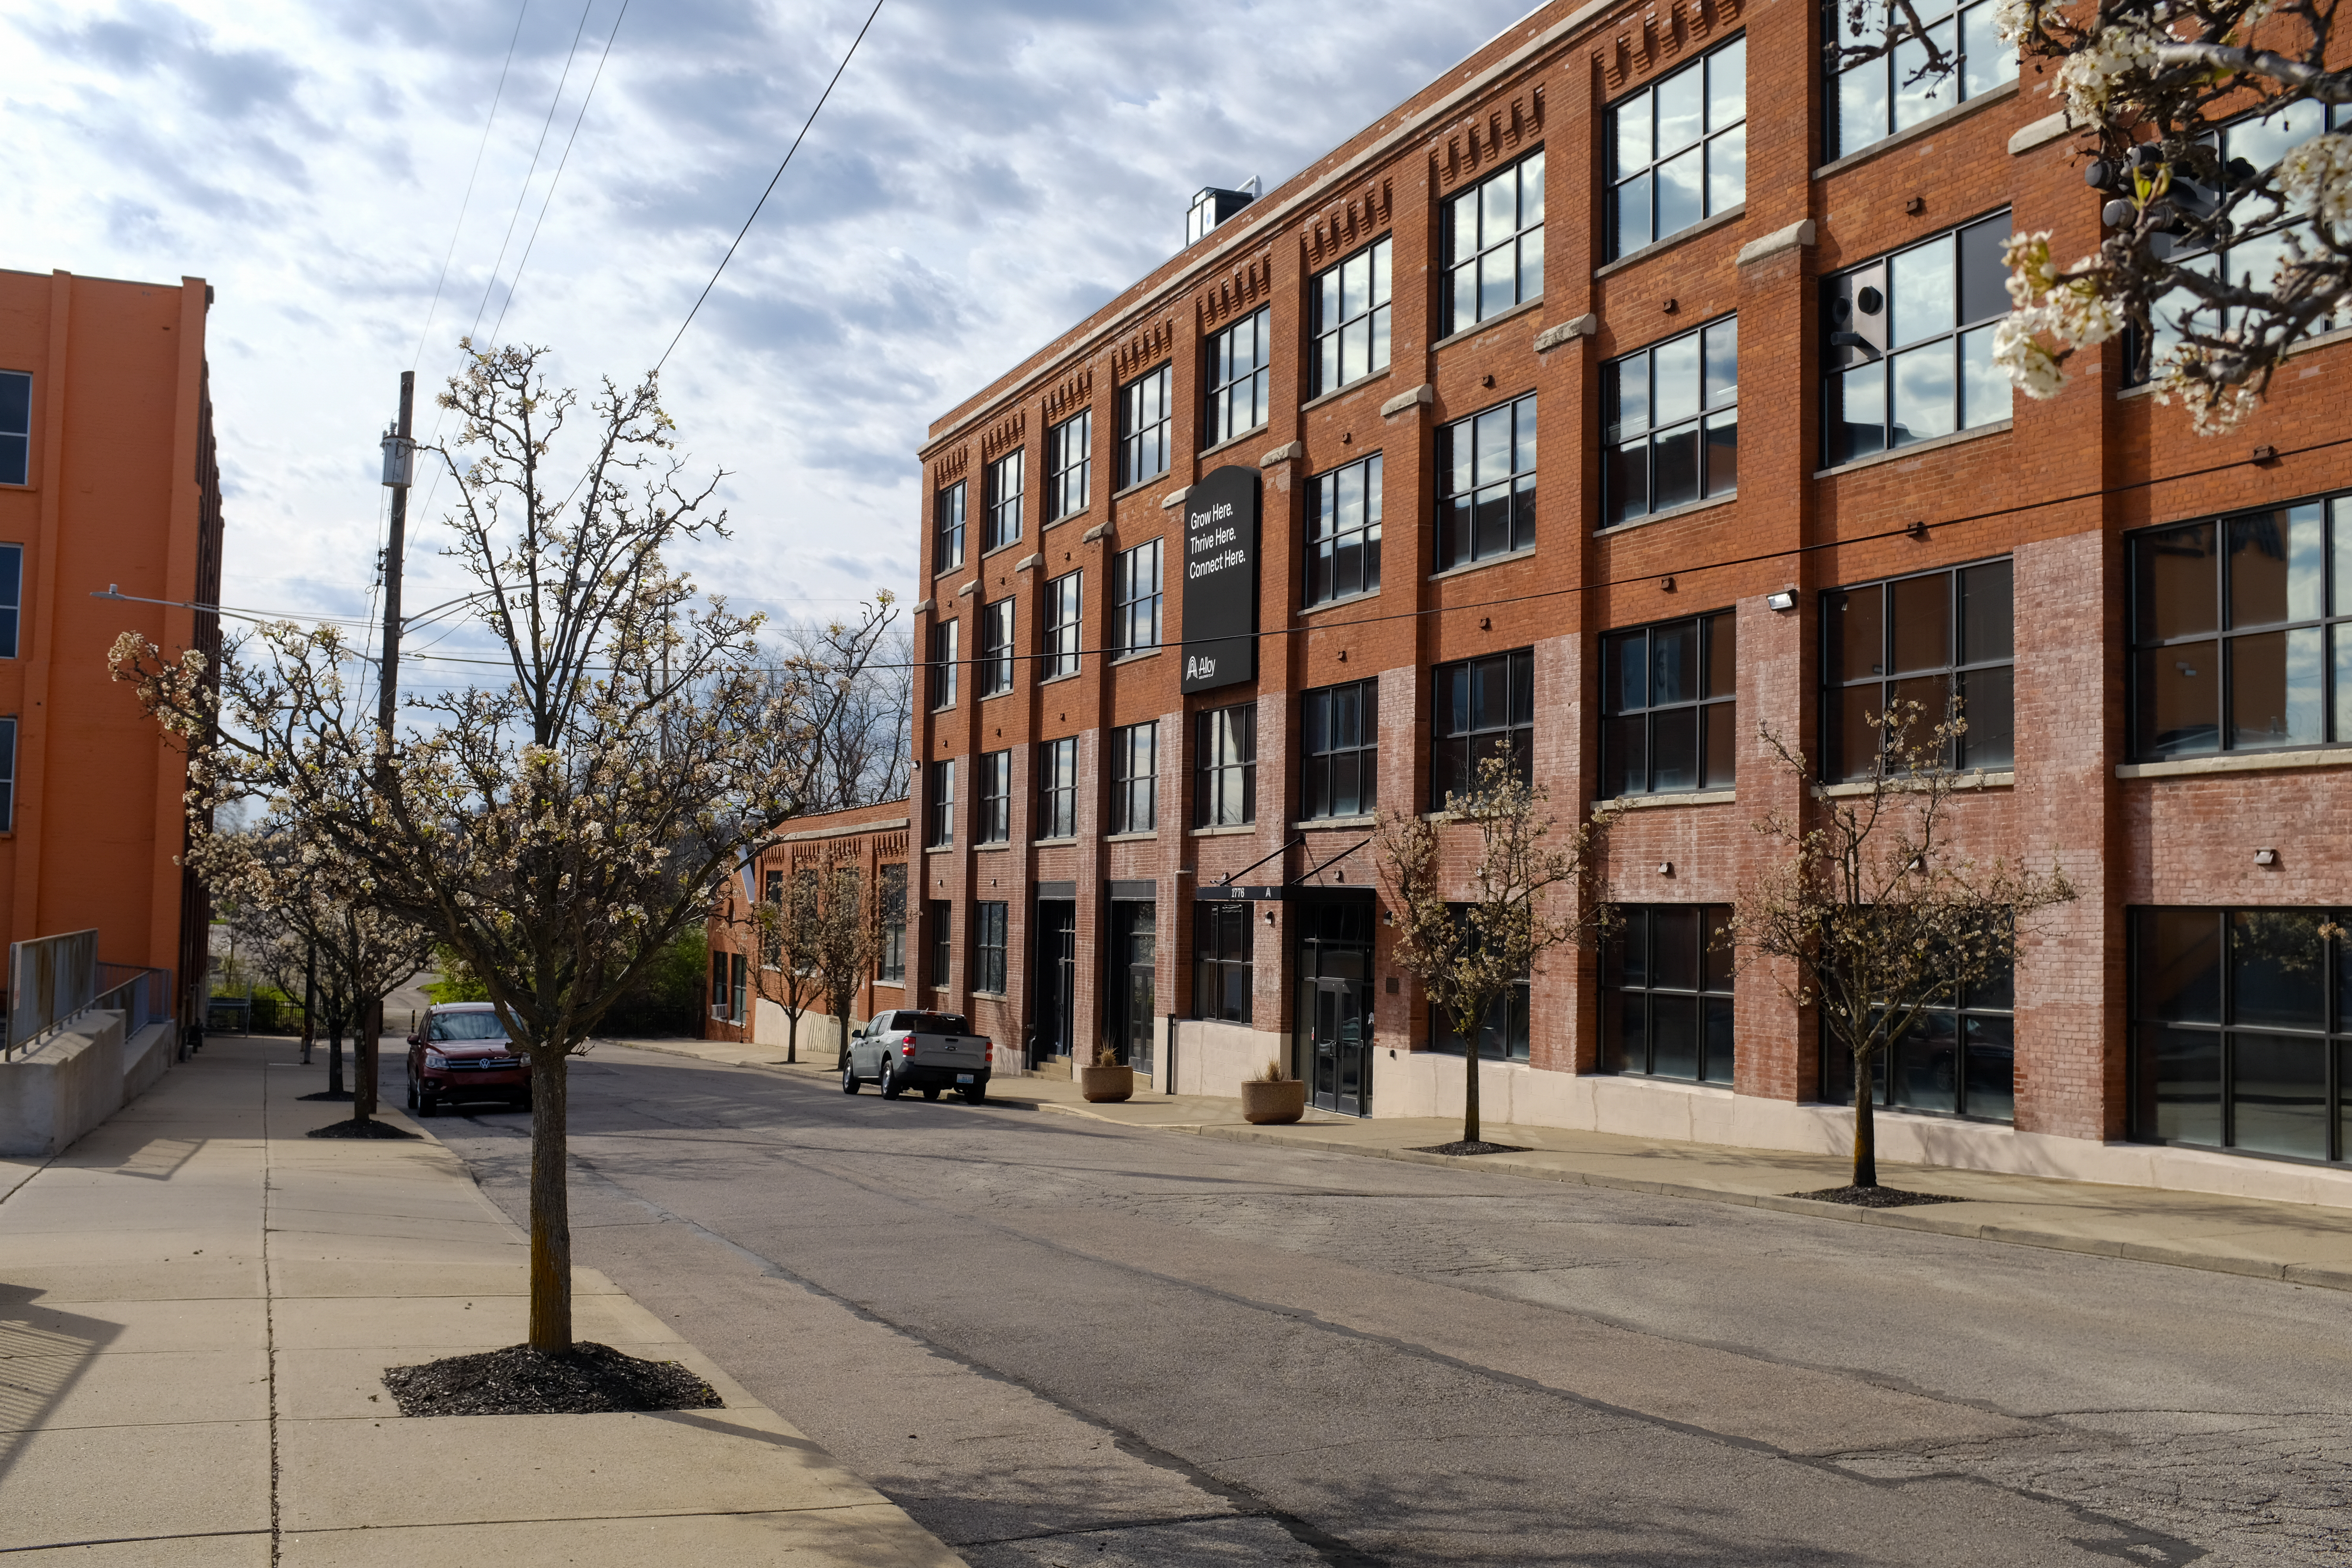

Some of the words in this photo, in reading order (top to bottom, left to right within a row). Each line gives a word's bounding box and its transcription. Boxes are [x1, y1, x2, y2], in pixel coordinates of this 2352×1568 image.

[1191, 510, 1211, 530] Grow
[1212, 503, 1233, 522] Here.
[1190, 533, 1214, 555] Thrive
[1216, 527, 1236, 546] Here.
[1190, 553, 1223, 579] Connect
[1225, 549, 1245, 568] Here.
[1198, 656, 1216, 677] Alloy
[1231, 887, 1245, 898] 1776
